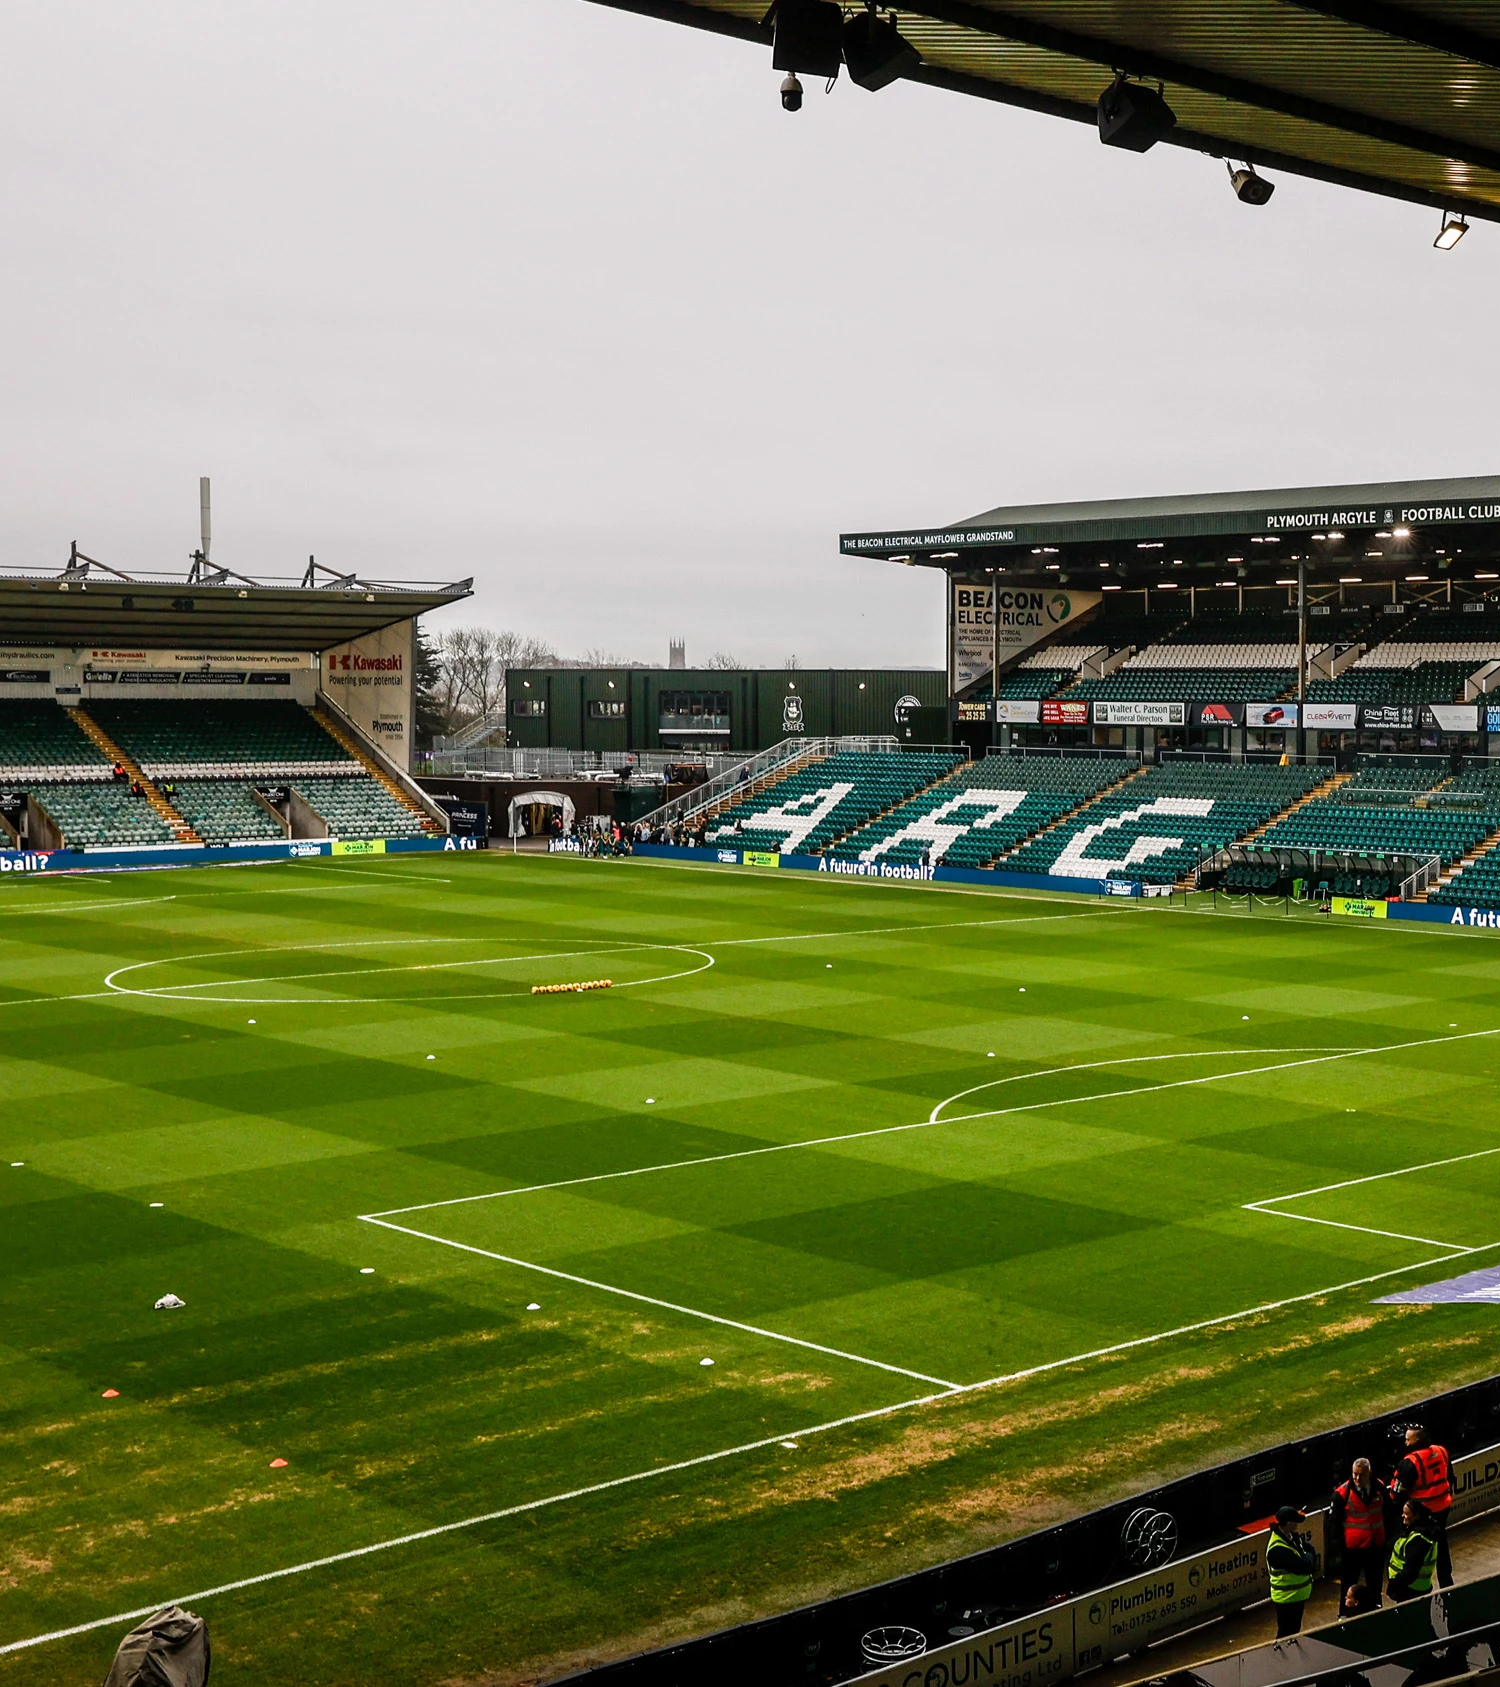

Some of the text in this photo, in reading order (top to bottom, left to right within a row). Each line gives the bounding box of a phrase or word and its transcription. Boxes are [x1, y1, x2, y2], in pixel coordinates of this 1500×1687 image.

[1267, 511, 1377, 528] PLYMOUTH ARGYLE
[1401, 506, 1466, 522] FOOTBALL
[843, 531, 1014, 549] THE BEACON ELECTRICAL MAYFLOWER GRANDSTAND
[958, 611, 1043, 626] ELECRICAL
[111, 651, 147, 659] Kawasaki
[270, 656, 300, 664] Plymouth
[958, 650, 982, 658] Whirlpool
[353, 655, 402, 670] Kawasaki
[329, 675, 403, 687] Powering your potential
[958, 701, 974, 711] TOWER
[1109, 704, 1168, 714] Walter C. Parson
[1364, 708, 1399, 717] China Fleet
[1113, 714, 1135, 722] Funeral
[372, 721, 404, 733] Plymouth
[444, 836, 477, 851] A fu
[0, 854, 49, 872] ball?
[818, 857, 936, 881] A future in football?
[1450, 907, 1464, 925] A
[1209, 1549, 1259, 1578] Heating
[1206, 1573, 1258, 1600] Mob: 07734
[1111, 1580, 1175, 1615] Plumbing
[1112, 1594, 1197, 1636] Tel: 01752 695 550
[903, 1622, 1054, 1687] COUNTIES
[1038, 1660, 1063, 1683] Ltd
